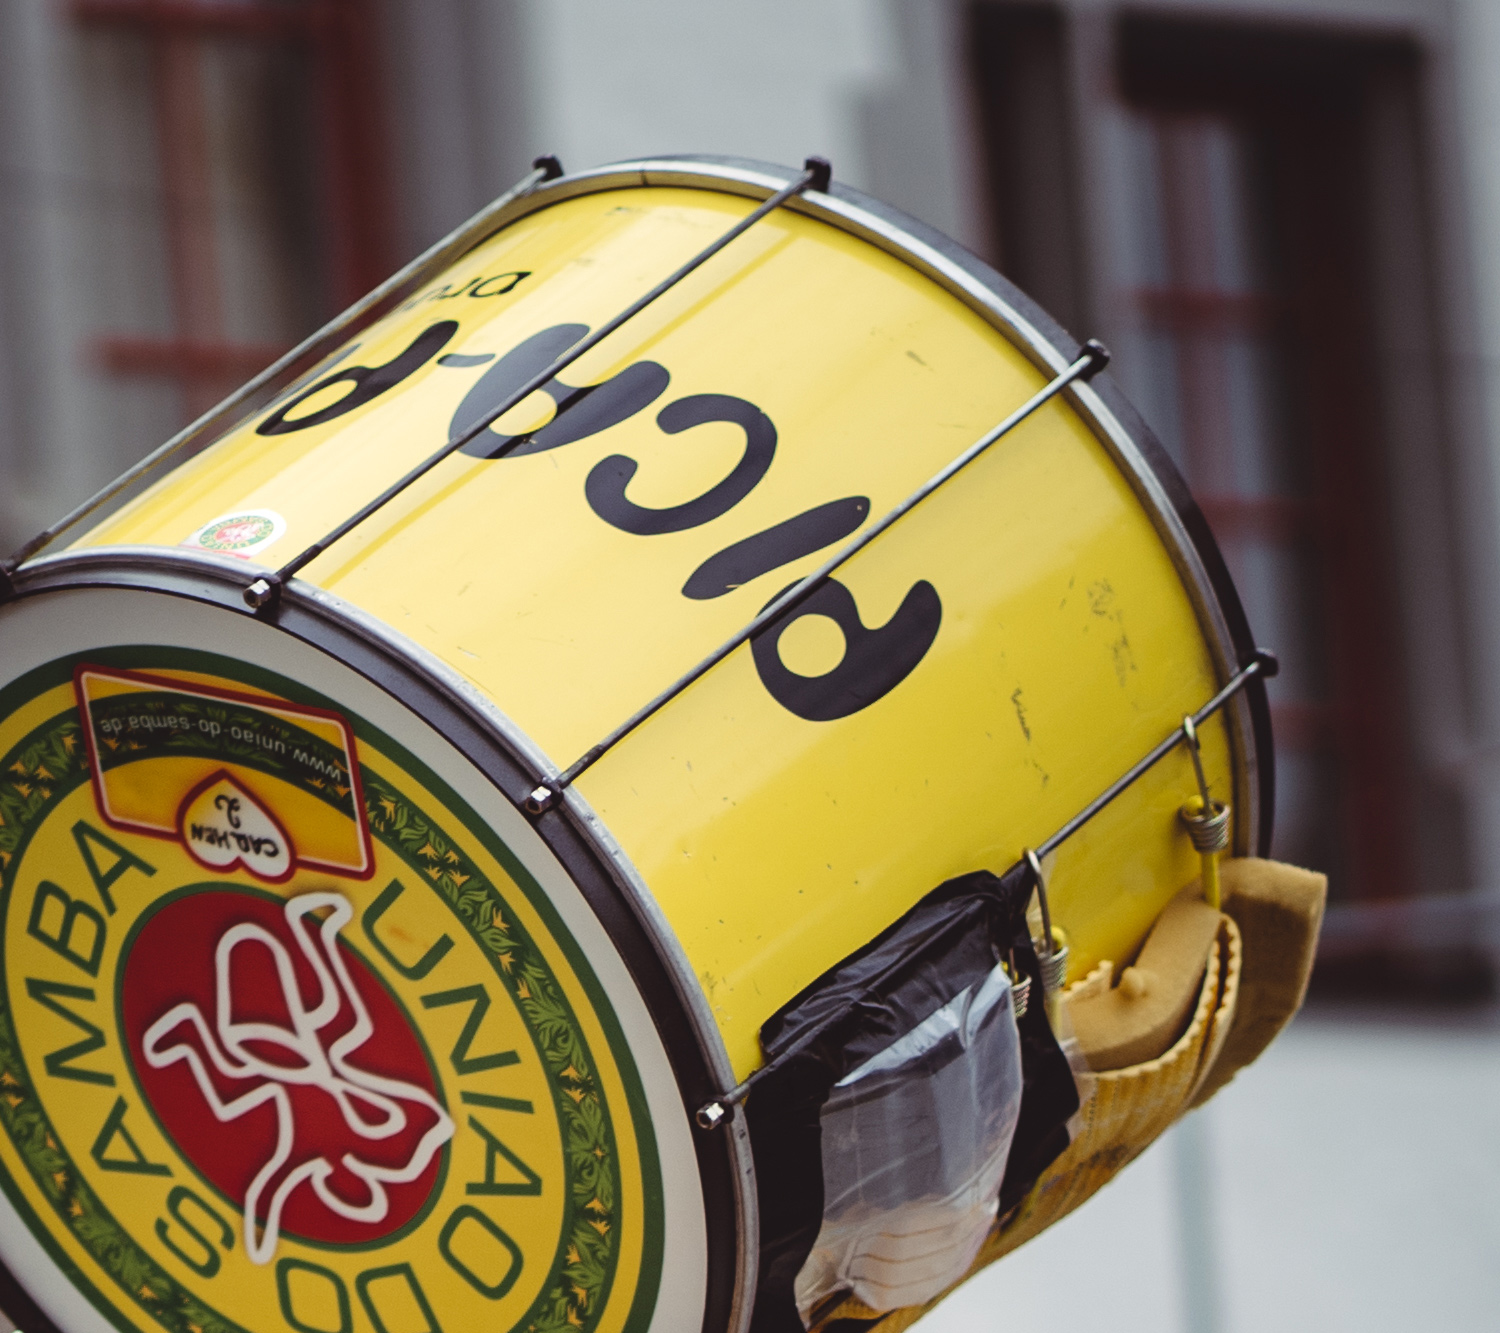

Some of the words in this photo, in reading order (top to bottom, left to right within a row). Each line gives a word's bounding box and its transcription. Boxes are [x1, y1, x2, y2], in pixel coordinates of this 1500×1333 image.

[255, 319, 944, 723] PICA-P
[24, 817, 237, 1280] SAMBA
[359, 878, 543, 1301] UNIAO
